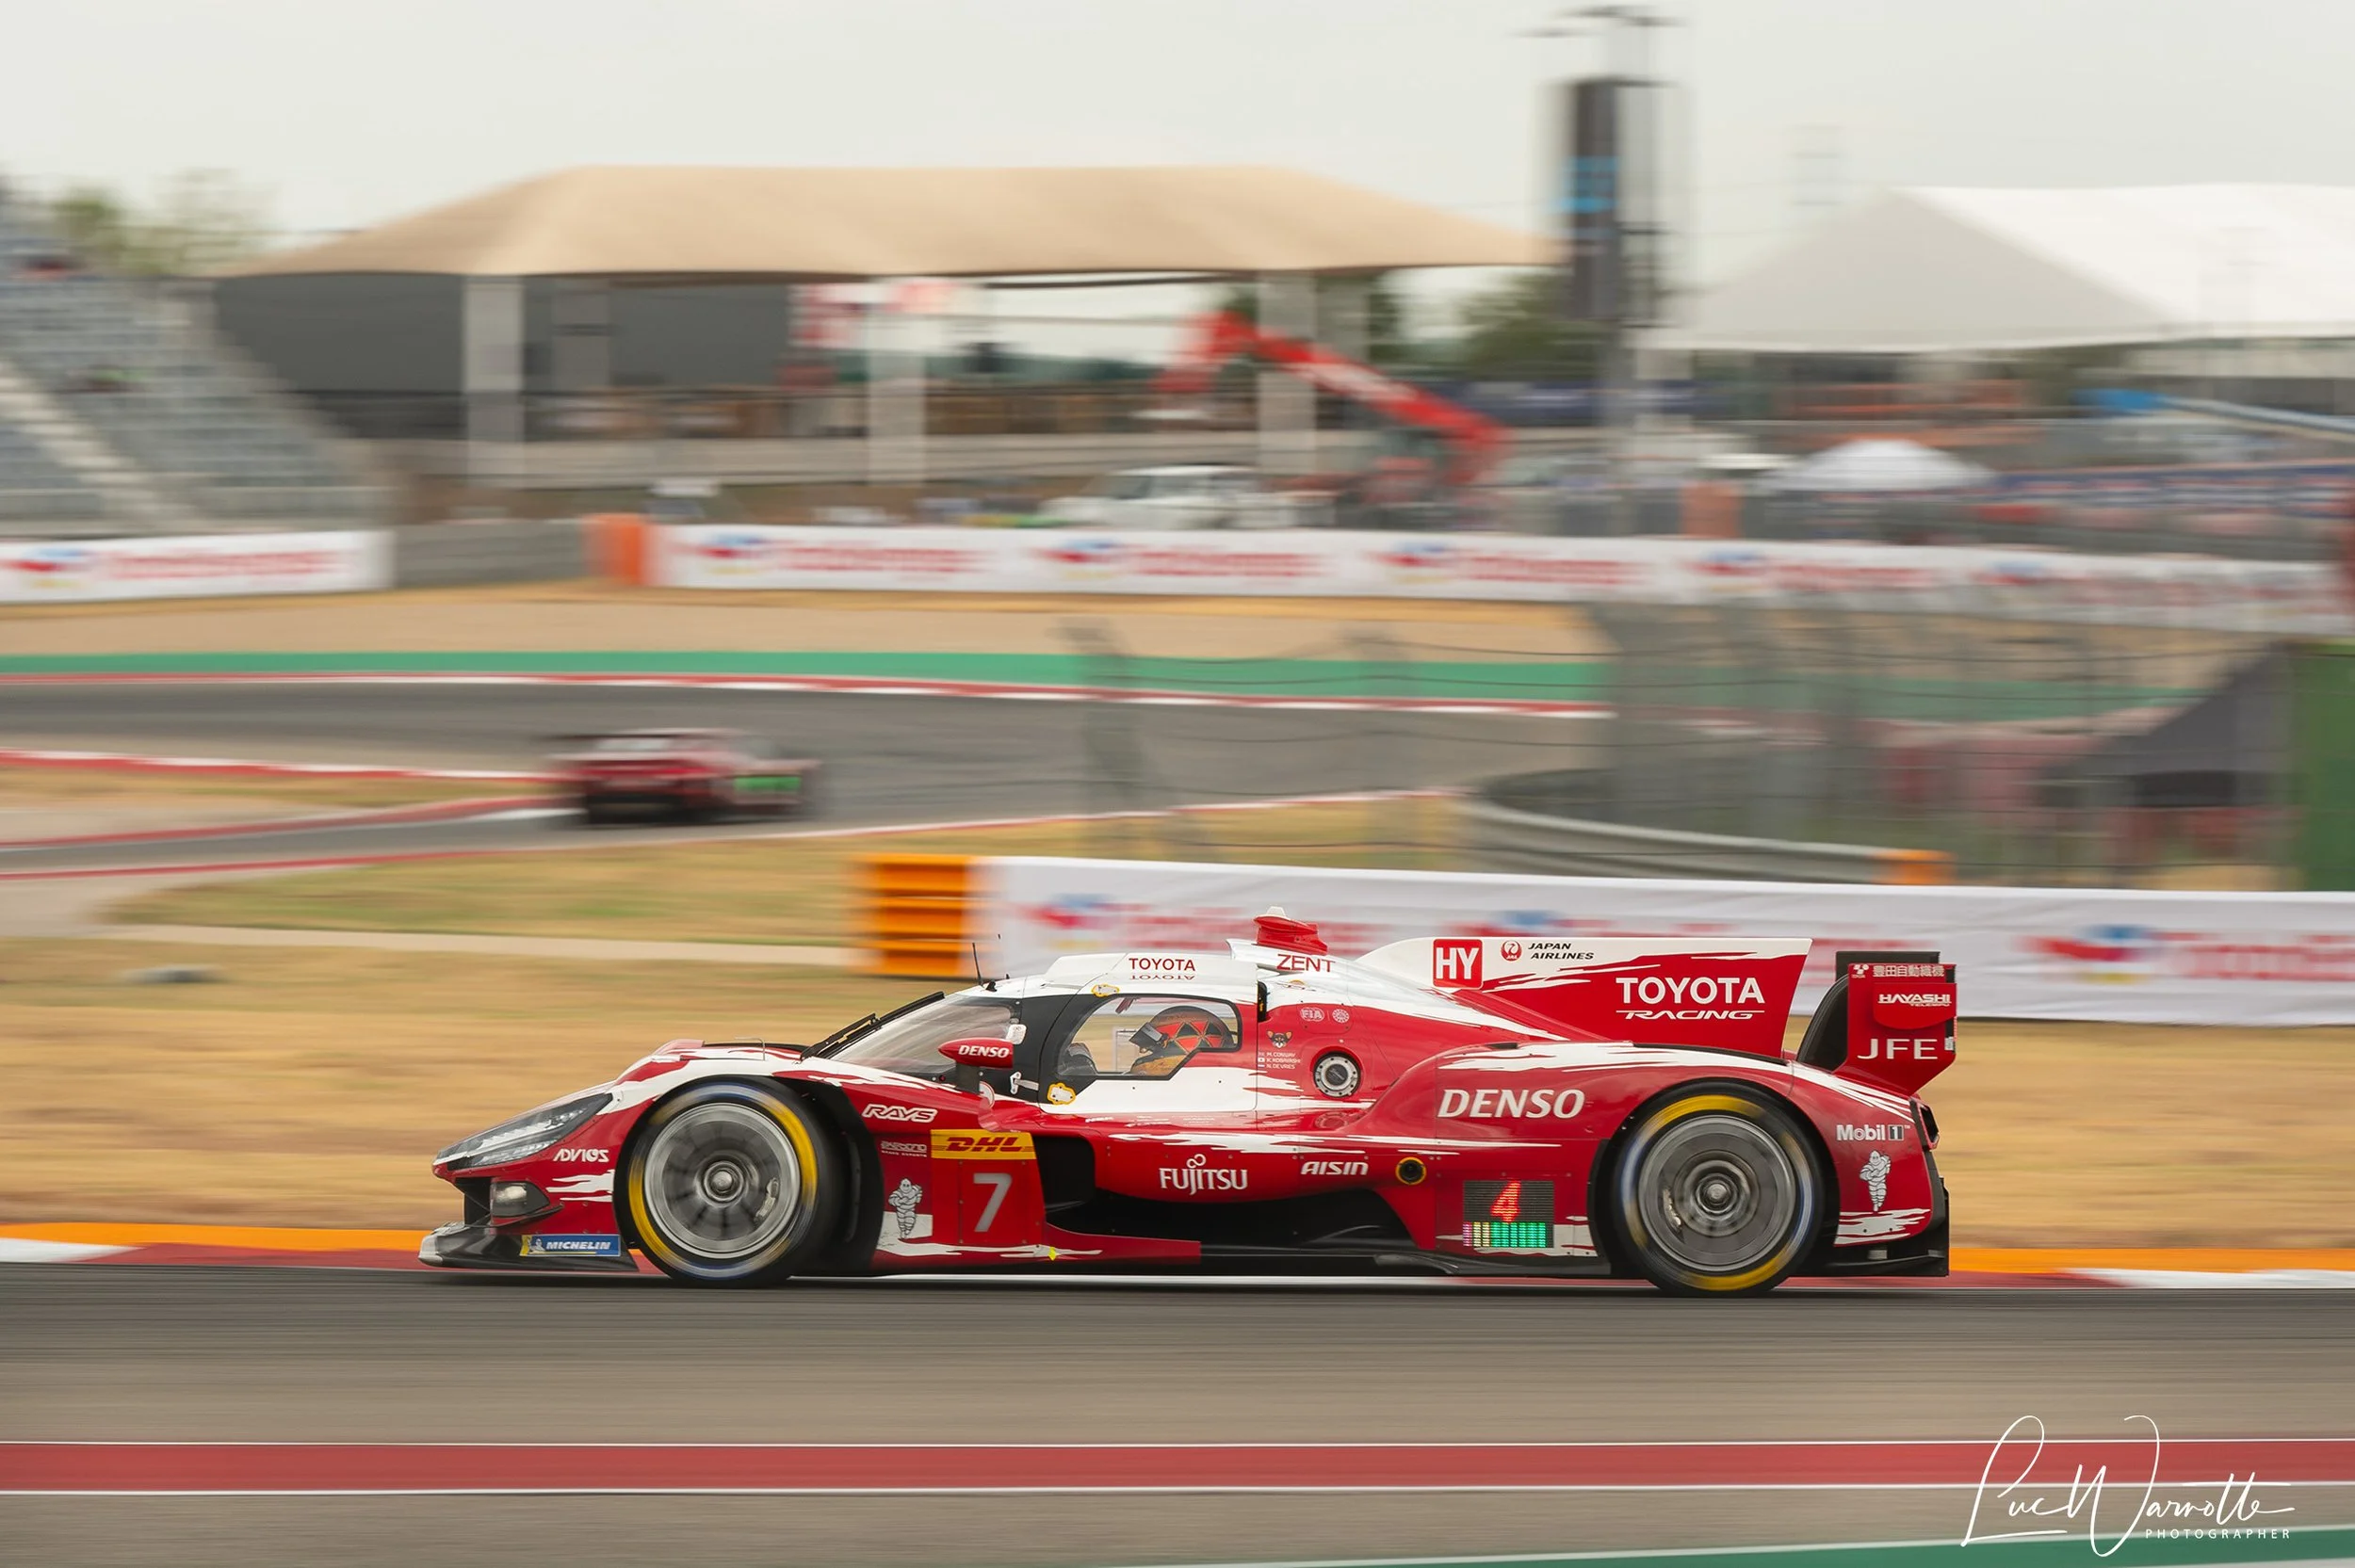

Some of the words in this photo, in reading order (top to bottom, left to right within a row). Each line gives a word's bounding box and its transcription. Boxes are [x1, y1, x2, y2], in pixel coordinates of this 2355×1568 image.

[1129, 958, 1196, 971] TOYOTA
[1276, 953, 1336, 973] ZENT
[1436, 947, 1479, 979] HY
[1616, 977, 1765, 1005] TOYOTA
[1878, 994, 1952, 1004] HAYASHI
[1616, 1010, 1764, 1020] RACING
[958, 1044, 1010, 1058] DENSO
[1857, 1039, 1938, 1059] JFE
[862, 1104, 938, 1123] RAYS
[1437, 1089, 1585, 1119] DENSO
[1836, 1124, 1886, 1141] Mobil
[946, 1137, 1022, 1153] DHL
[1300, 1161, 1369, 1175] AISIN
[1159, 1168, 1248, 1195] FUJITSU
[973, 1172, 1013, 1233] 7
[1490, 1180, 1522, 1222] 4
[546, 1241, 611, 1250] MICHELIN
